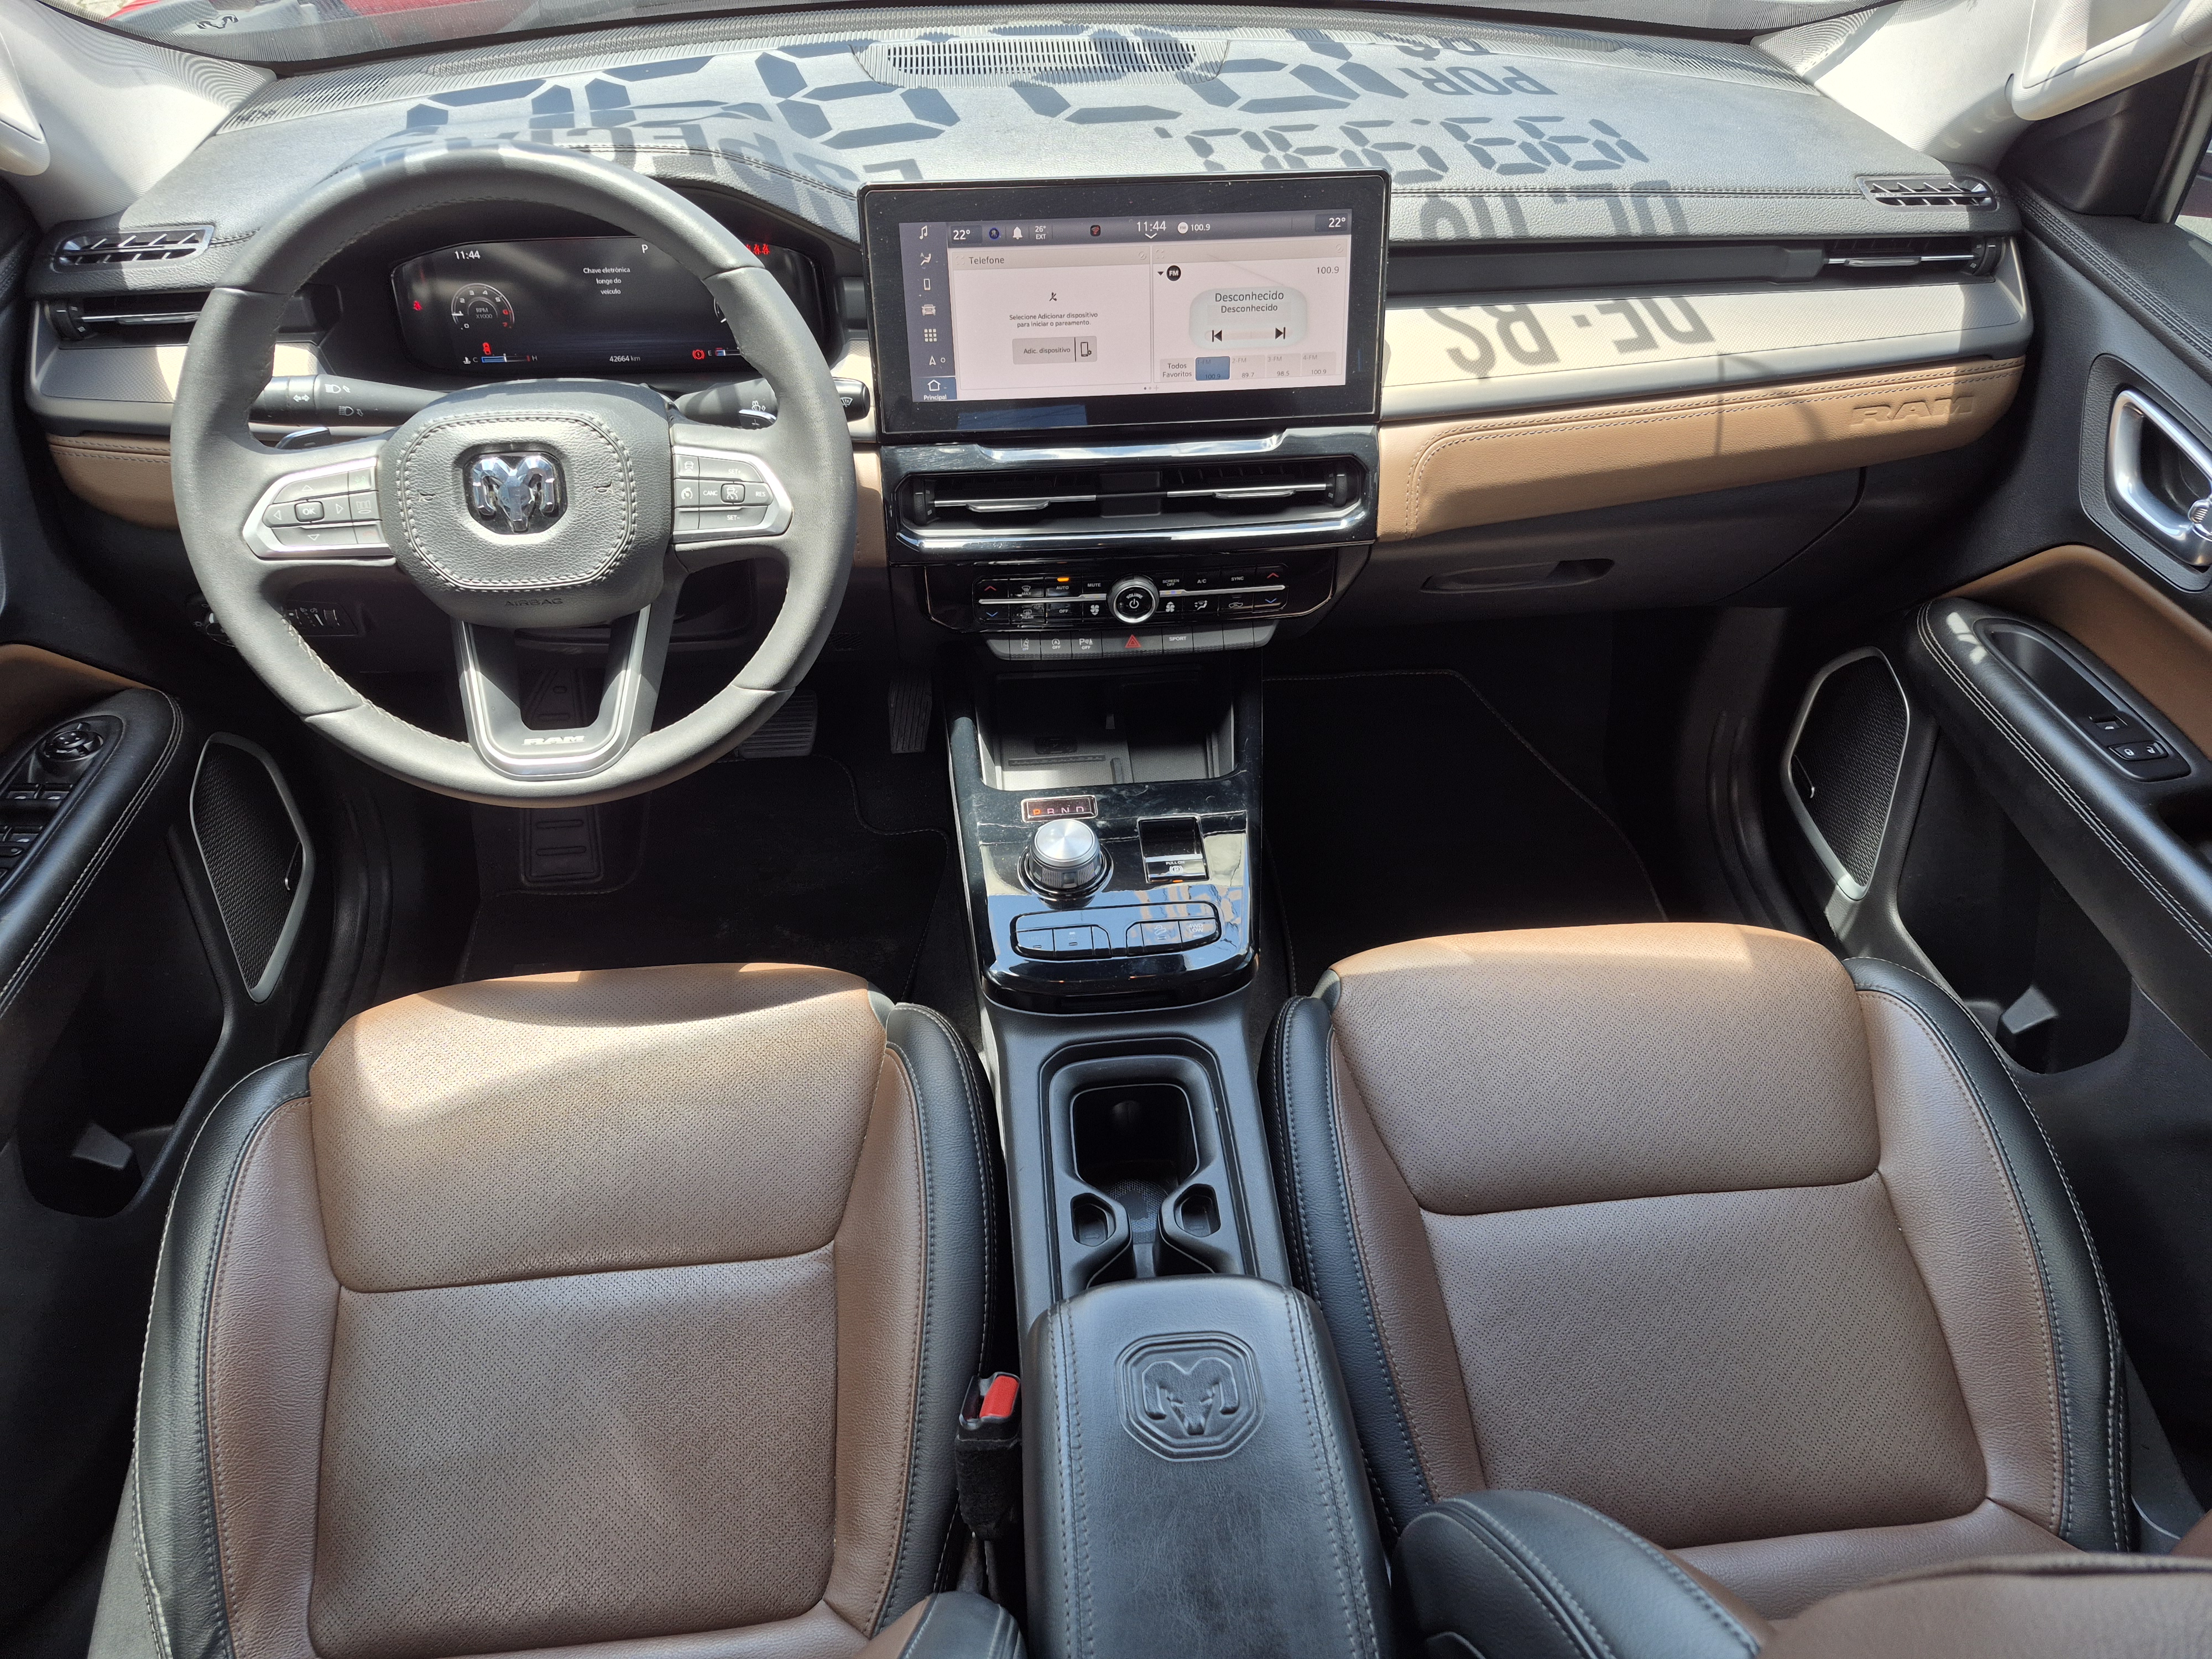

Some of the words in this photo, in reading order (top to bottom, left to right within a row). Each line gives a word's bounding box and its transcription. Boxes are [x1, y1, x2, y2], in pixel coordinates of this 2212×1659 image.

[1136, 221, 1166, 232] 11:44
[1328, 217, 1346, 228] 22°
[953, 229, 971, 240] 22°
[641, 244, 648, 254] P
[455, 251, 481, 260] 11:44
[969, 256, 1005, 264] Telefone
[1215, 290, 1284, 302] Desconhecido
[1221, 304, 1278, 313] Desconhecido
[1851, 395, 1975, 427] RAM
[505, 598, 563, 606] AIRBAG
[521, 735, 585, 745] RAM
